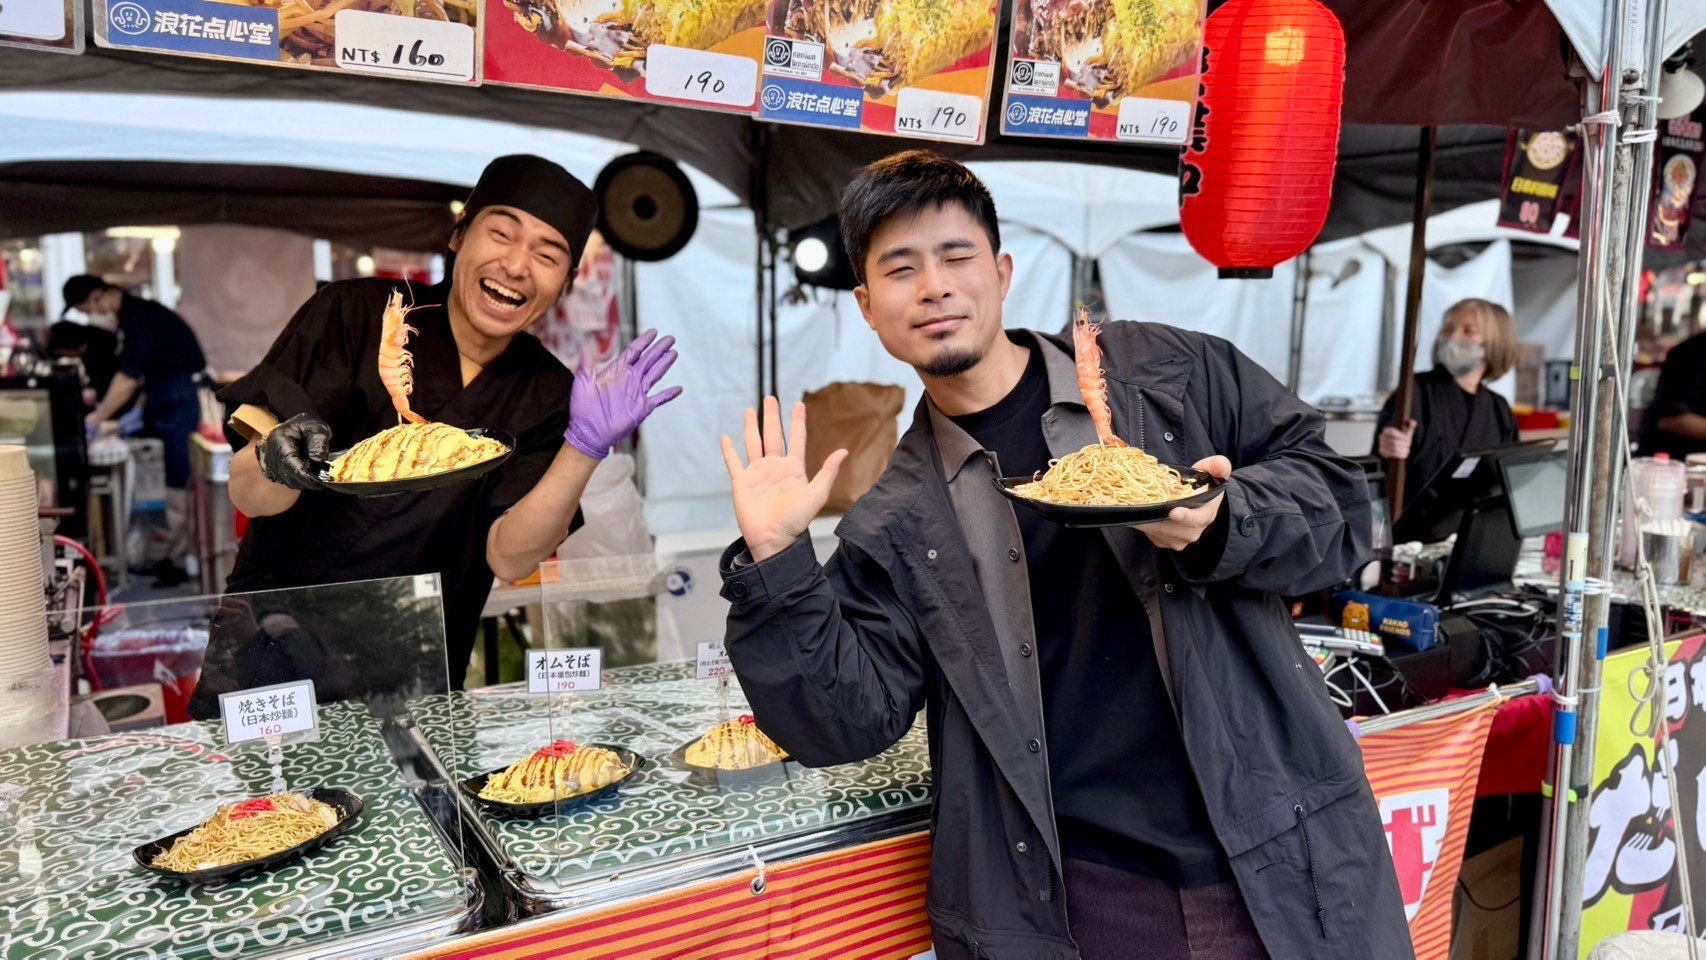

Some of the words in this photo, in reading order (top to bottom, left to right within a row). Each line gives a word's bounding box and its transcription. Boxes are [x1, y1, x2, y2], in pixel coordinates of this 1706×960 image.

[153, 10, 274, 46] 浪花点心堂
[342, 46, 380, 64] NT$
[392, 39, 445, 66] 160
[684, 71, 725, 94] 190
[786, 90, 860, 117] 浪花点心堂
[898, 117, 922, 129] NT$
[930, 106, 966, 128] 190
[1027, 106, 1088, 127] 浪花点心堂
[1119, 124, 1140, 134] NT$
[1150, 116, 1178, 135] 190
[1379, 624, 1411, 637] FRIENDS
[1382, 617, 1409, 628] KAKAO
[535, 653, 591, 670] オムそば
[708, 667, 725, 676] 220
[557, 681, 575, 689] 190
[238, 691, 295, 714] 焼きそば
[260, 724, 281, 735] 160
